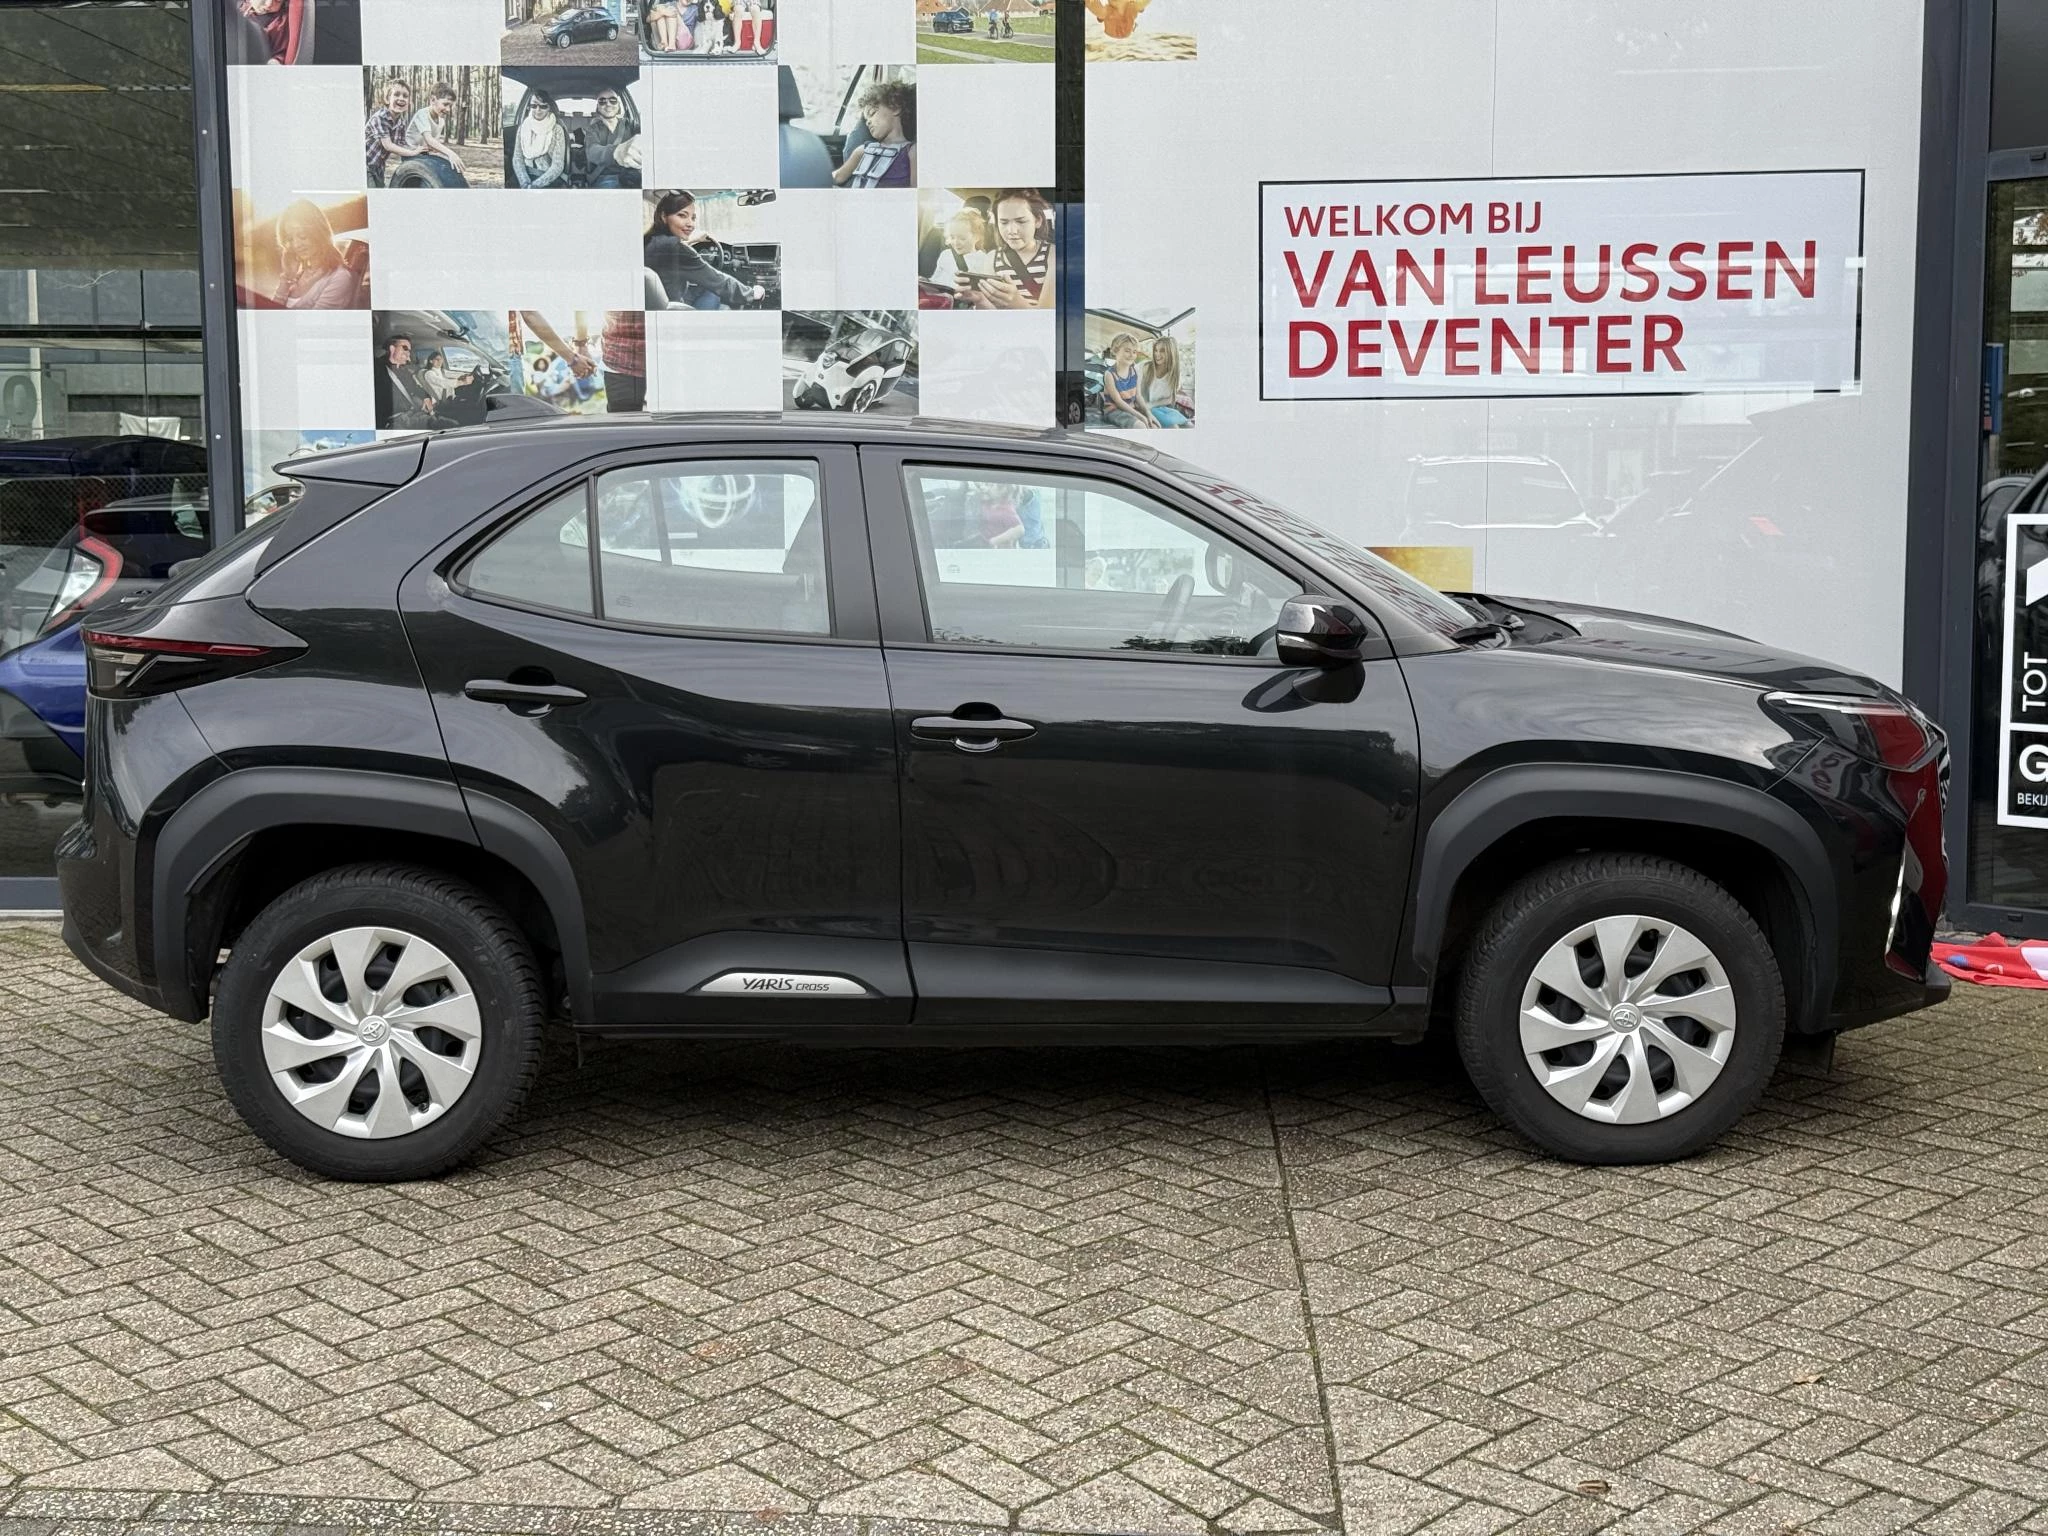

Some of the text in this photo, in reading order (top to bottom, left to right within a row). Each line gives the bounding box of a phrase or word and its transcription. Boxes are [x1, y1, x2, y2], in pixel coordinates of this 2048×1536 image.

[1285, 200, 1542, 238] WELKOM BIJ
[1283, 240, 1817, 308] VAN LEUSSEN
[1288, 314, 1685, 378] DEVENTER
[2021, 651, 2048, 713] TOT
[796, 983, 830, 992] CROSS
